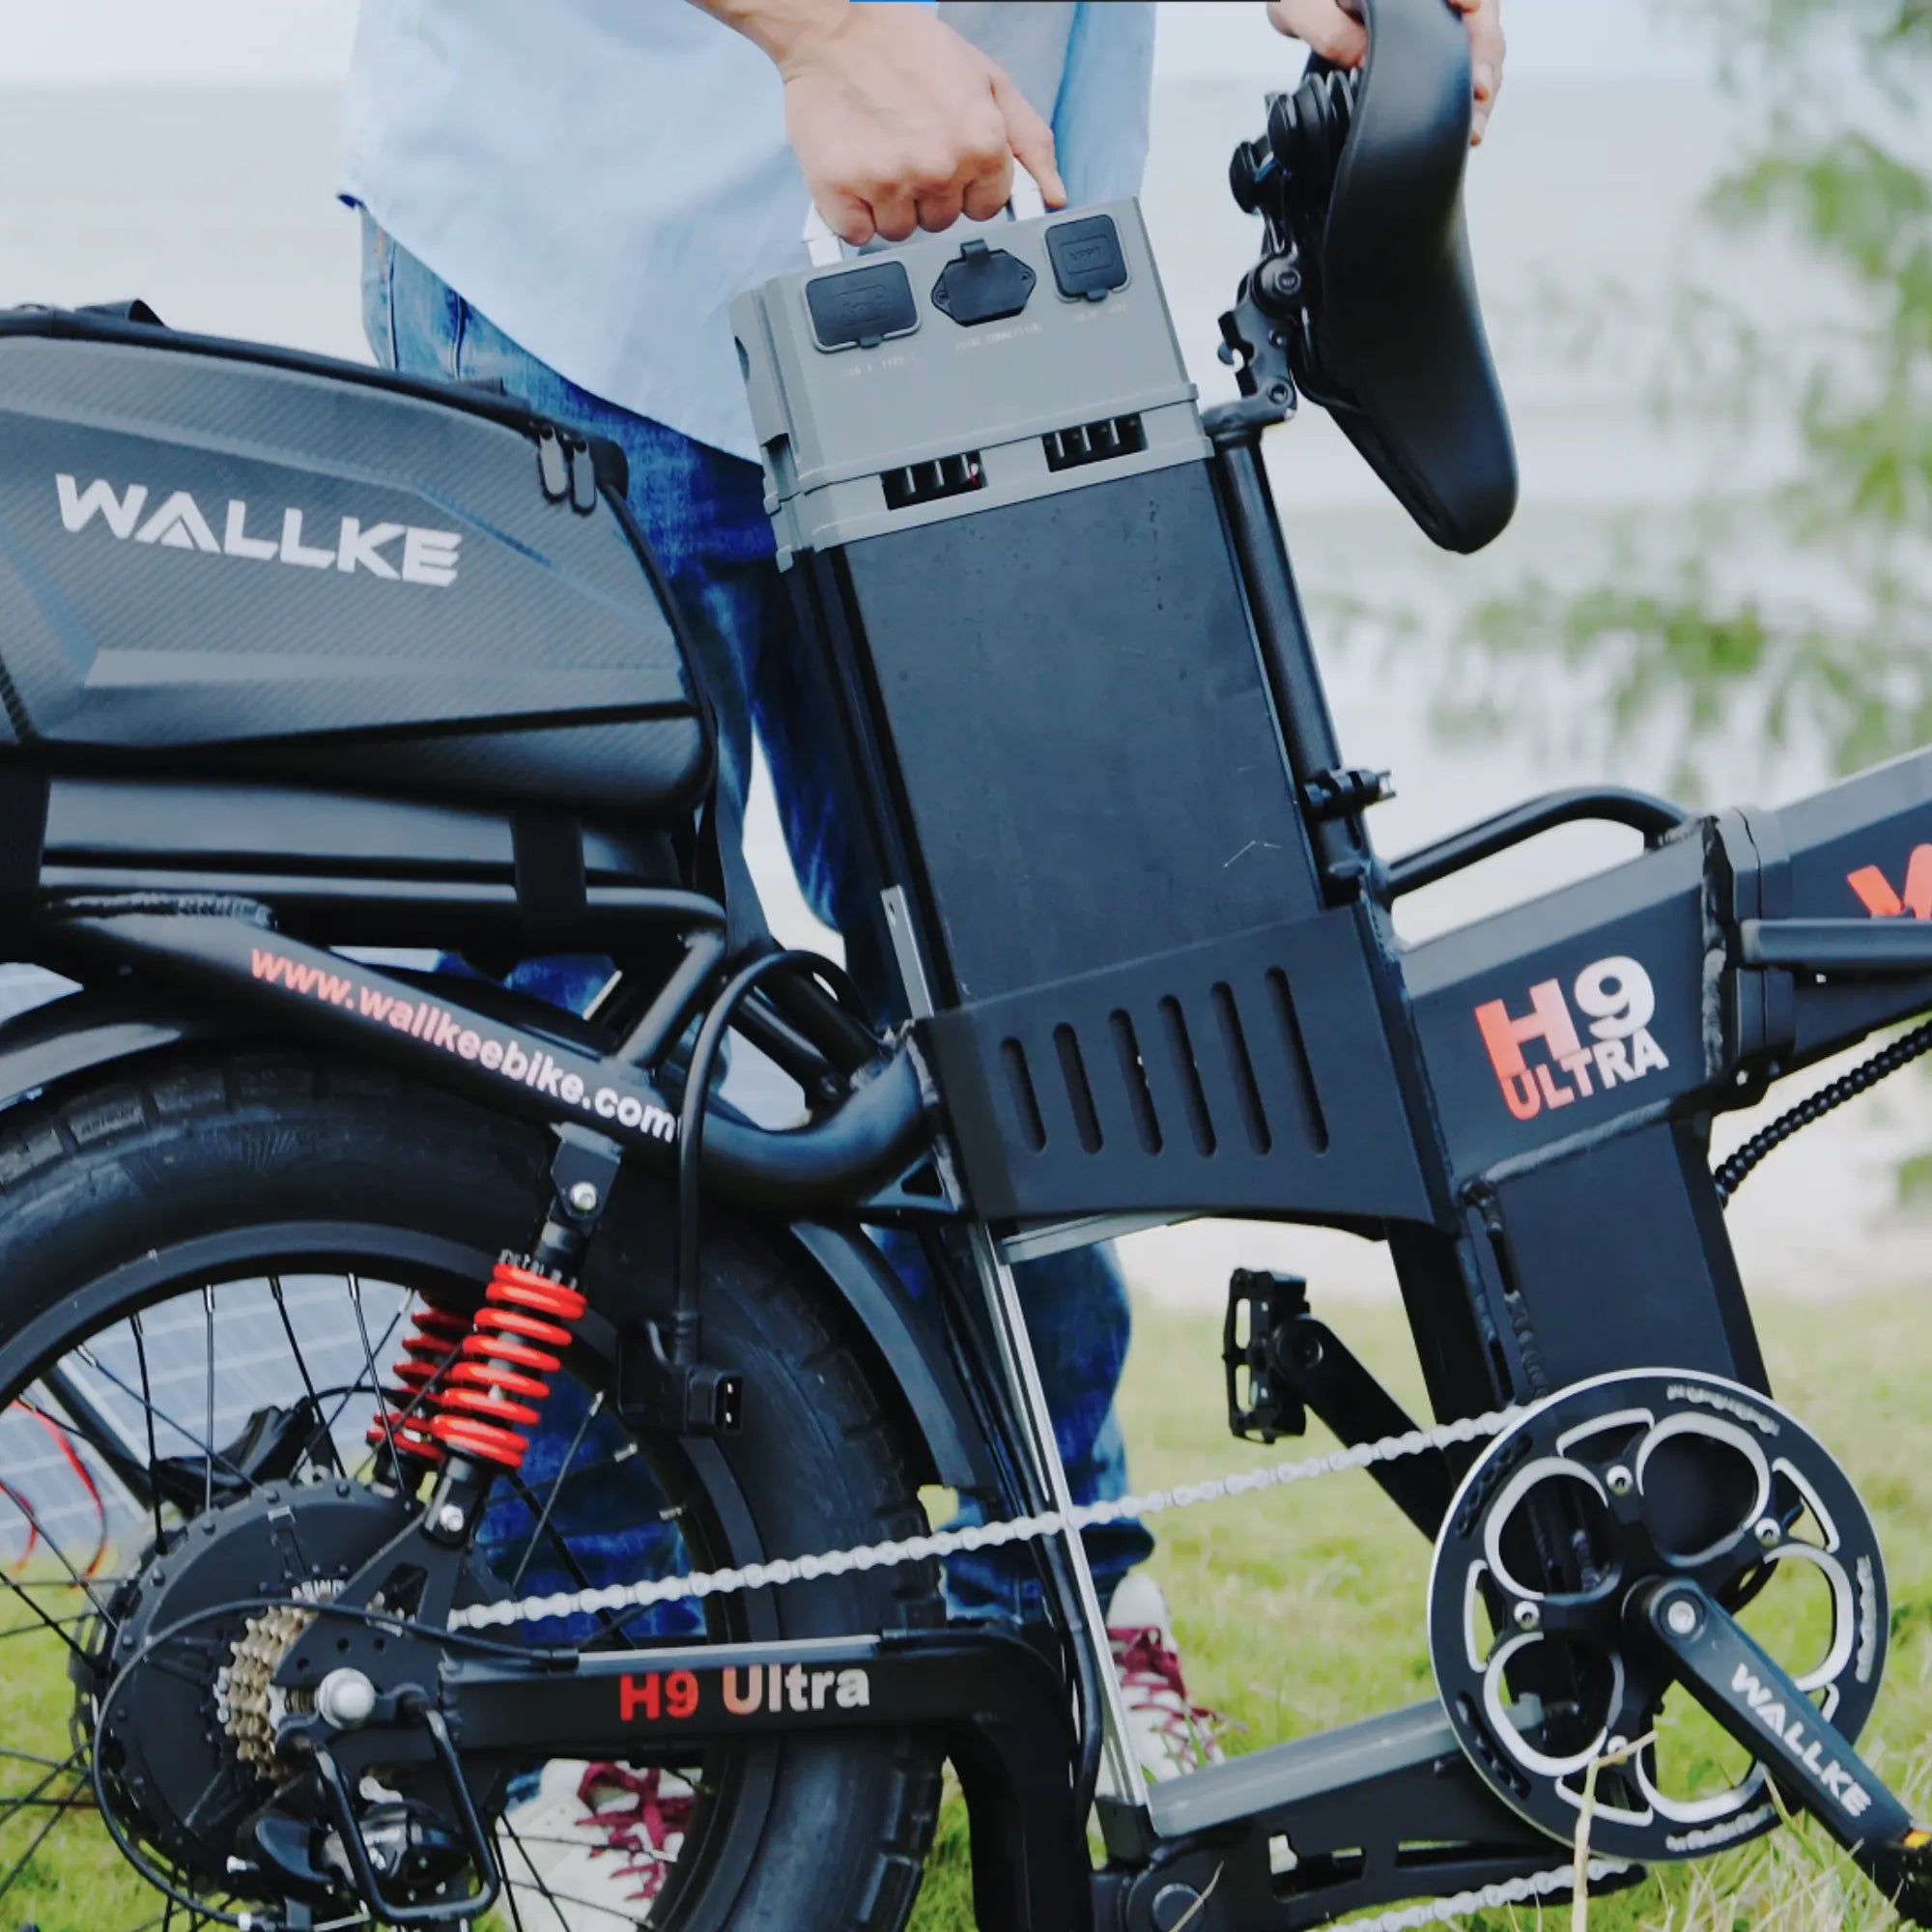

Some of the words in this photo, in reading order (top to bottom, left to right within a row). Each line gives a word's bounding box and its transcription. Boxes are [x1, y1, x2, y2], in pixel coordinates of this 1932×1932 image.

[55, 473, 464, 587] WALLKE
[251, 949, 676, 1144] www.wallkeebike.com
[1474, 954, 1656, 1079] H9
[1499, 1027, 1670, 1121] ULTRA
[619, 1668, 699, 1722] H9
[722, 1662, 870, 1716] Ultra
[1730, 1662, 1872, 1817] WALLKE
